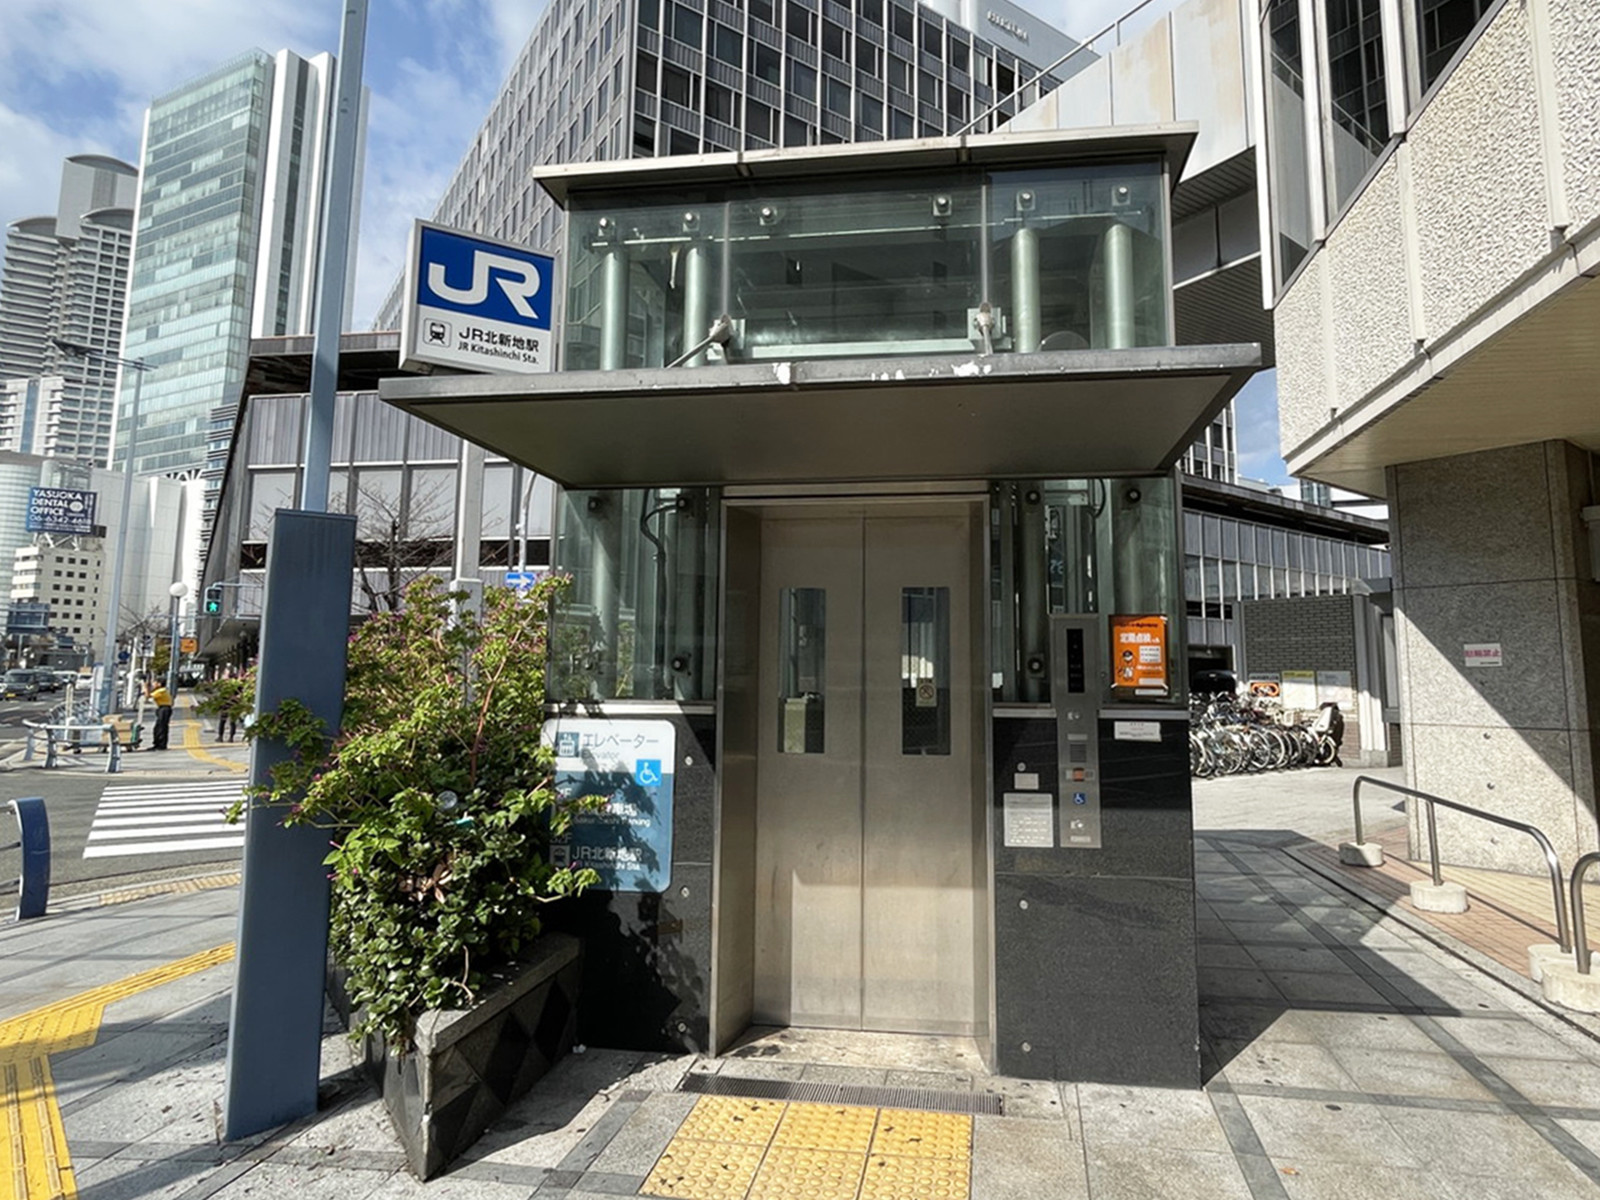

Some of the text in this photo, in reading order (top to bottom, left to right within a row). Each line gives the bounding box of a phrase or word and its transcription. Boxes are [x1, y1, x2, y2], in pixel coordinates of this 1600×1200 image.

[428, 250, 540, 319] JR
[459, 327, 539, 352] JR北新地駅
[458, 341, 539, 364] JR Kitashinchi Sta.
[33, 489, 82, 500] YASUOKA
[30, 506, 64, 516] OFFICE
[31, 498, 69, 508] DENTAL
[583, 733, 659, 749] エレベーター
